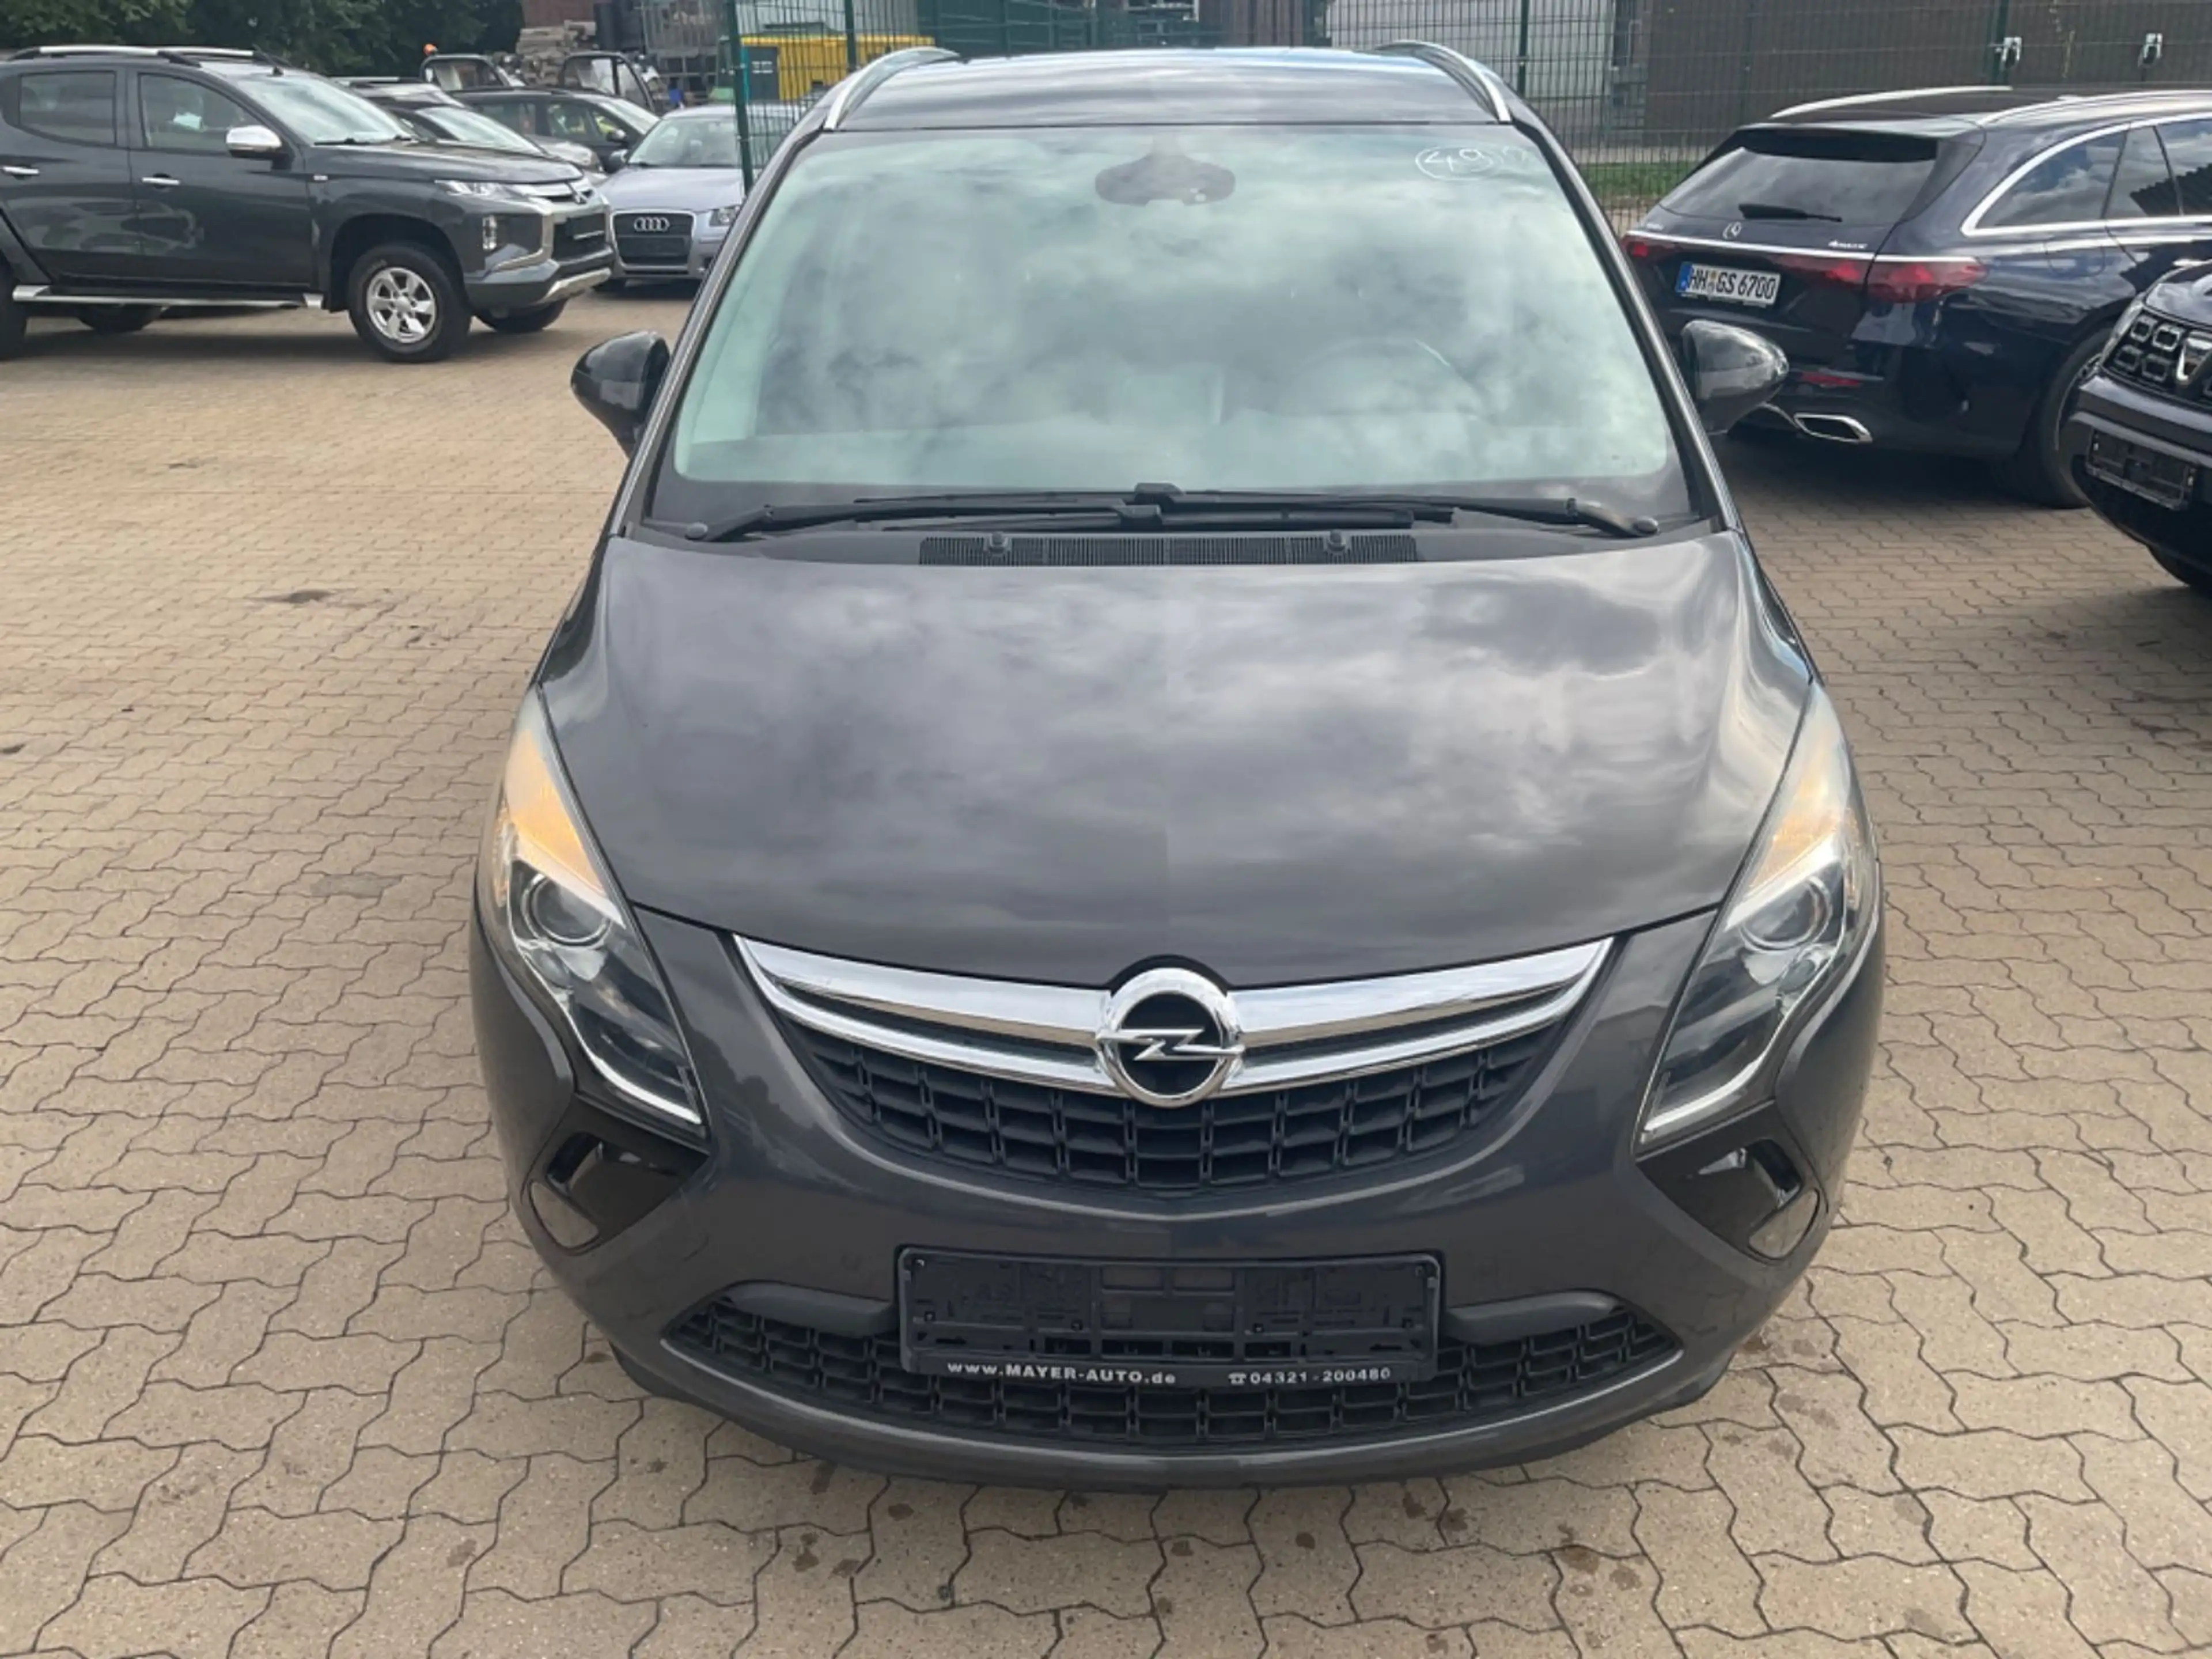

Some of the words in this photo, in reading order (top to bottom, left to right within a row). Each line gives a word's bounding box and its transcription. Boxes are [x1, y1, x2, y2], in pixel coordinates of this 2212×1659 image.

[1715, 272, 1737, 294] GS
[1738, 274, 1776, 300] 6700
[948, 1362, 1176, 1384] www.MAYER-AUTO.de
